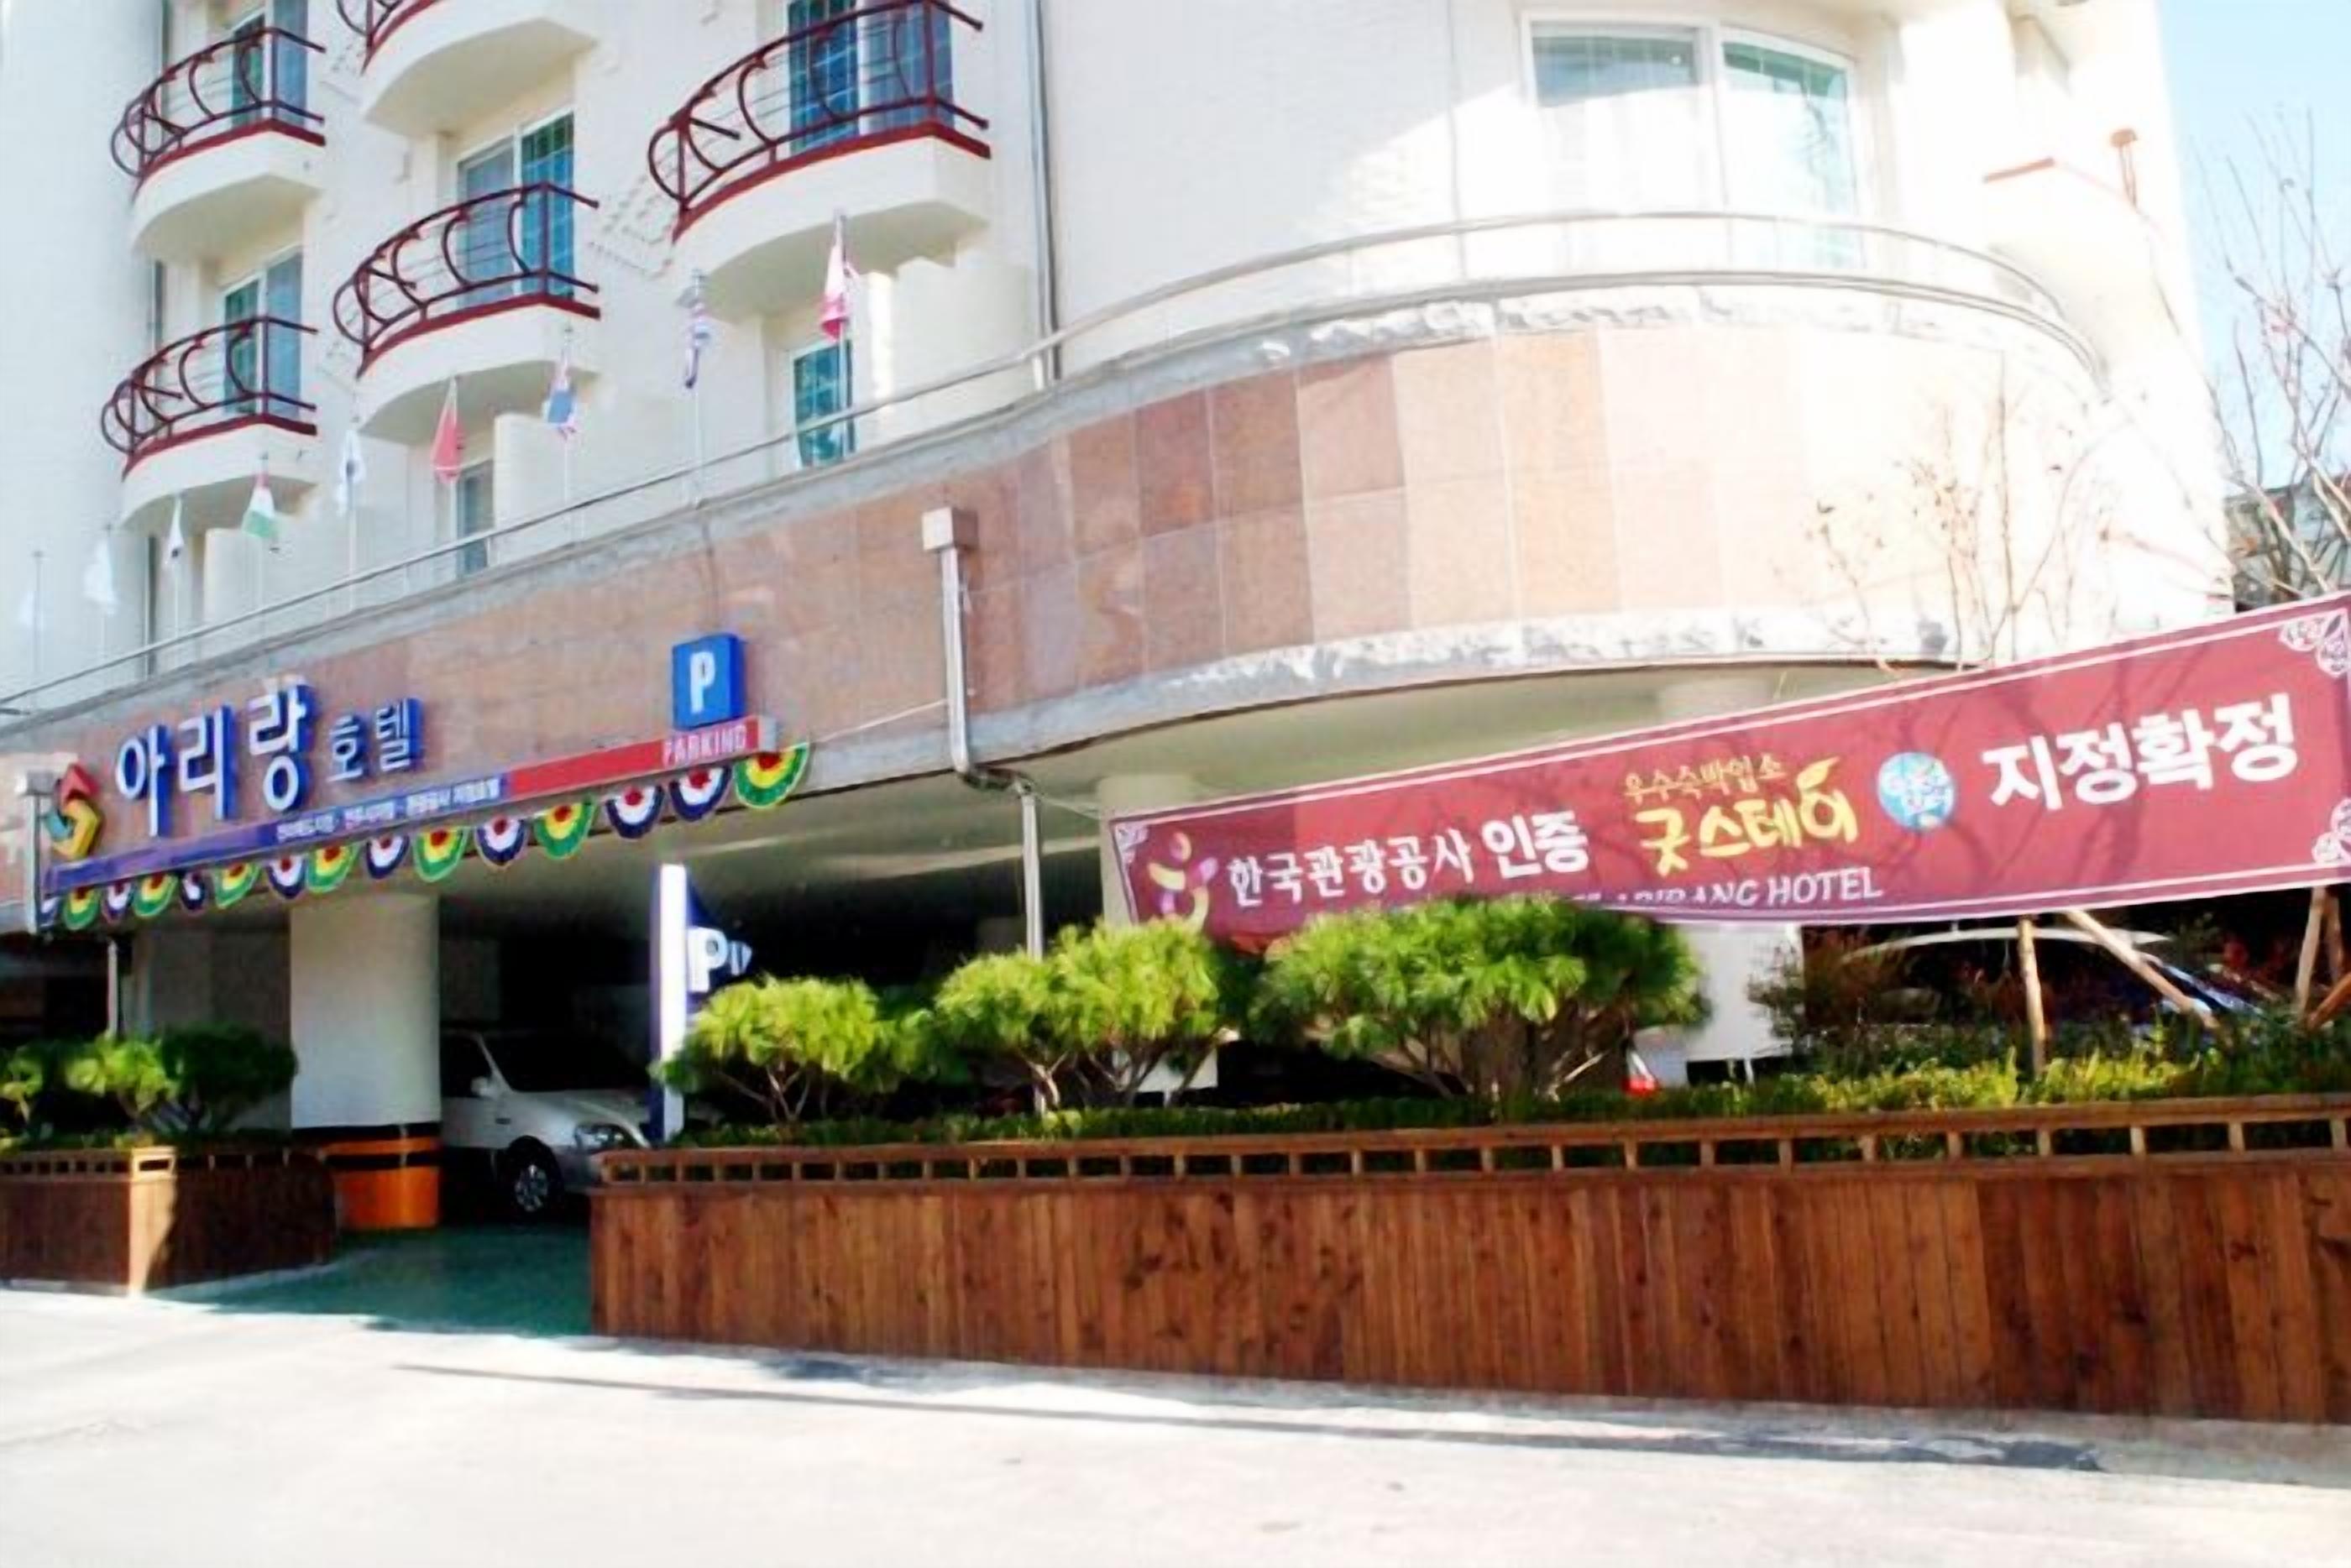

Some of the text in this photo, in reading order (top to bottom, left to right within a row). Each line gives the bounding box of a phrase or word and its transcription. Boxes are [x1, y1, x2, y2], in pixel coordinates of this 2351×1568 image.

[689, 650, 717, 715] P
[116, 682, 416, 837] 아리랑 호텔
[662, 724, 746, 769] PARKING
[1227, 827, 1475, 908] 한국관광공사
[1481, 809, 1590, 881] 인증
[1982, 693, 2299, 810] 지정확정
[1634, 756, 1859, 877] 굿스테이
[1765, 865, 1882, 907] HOTEL
[686, 926, 728, 994] P
